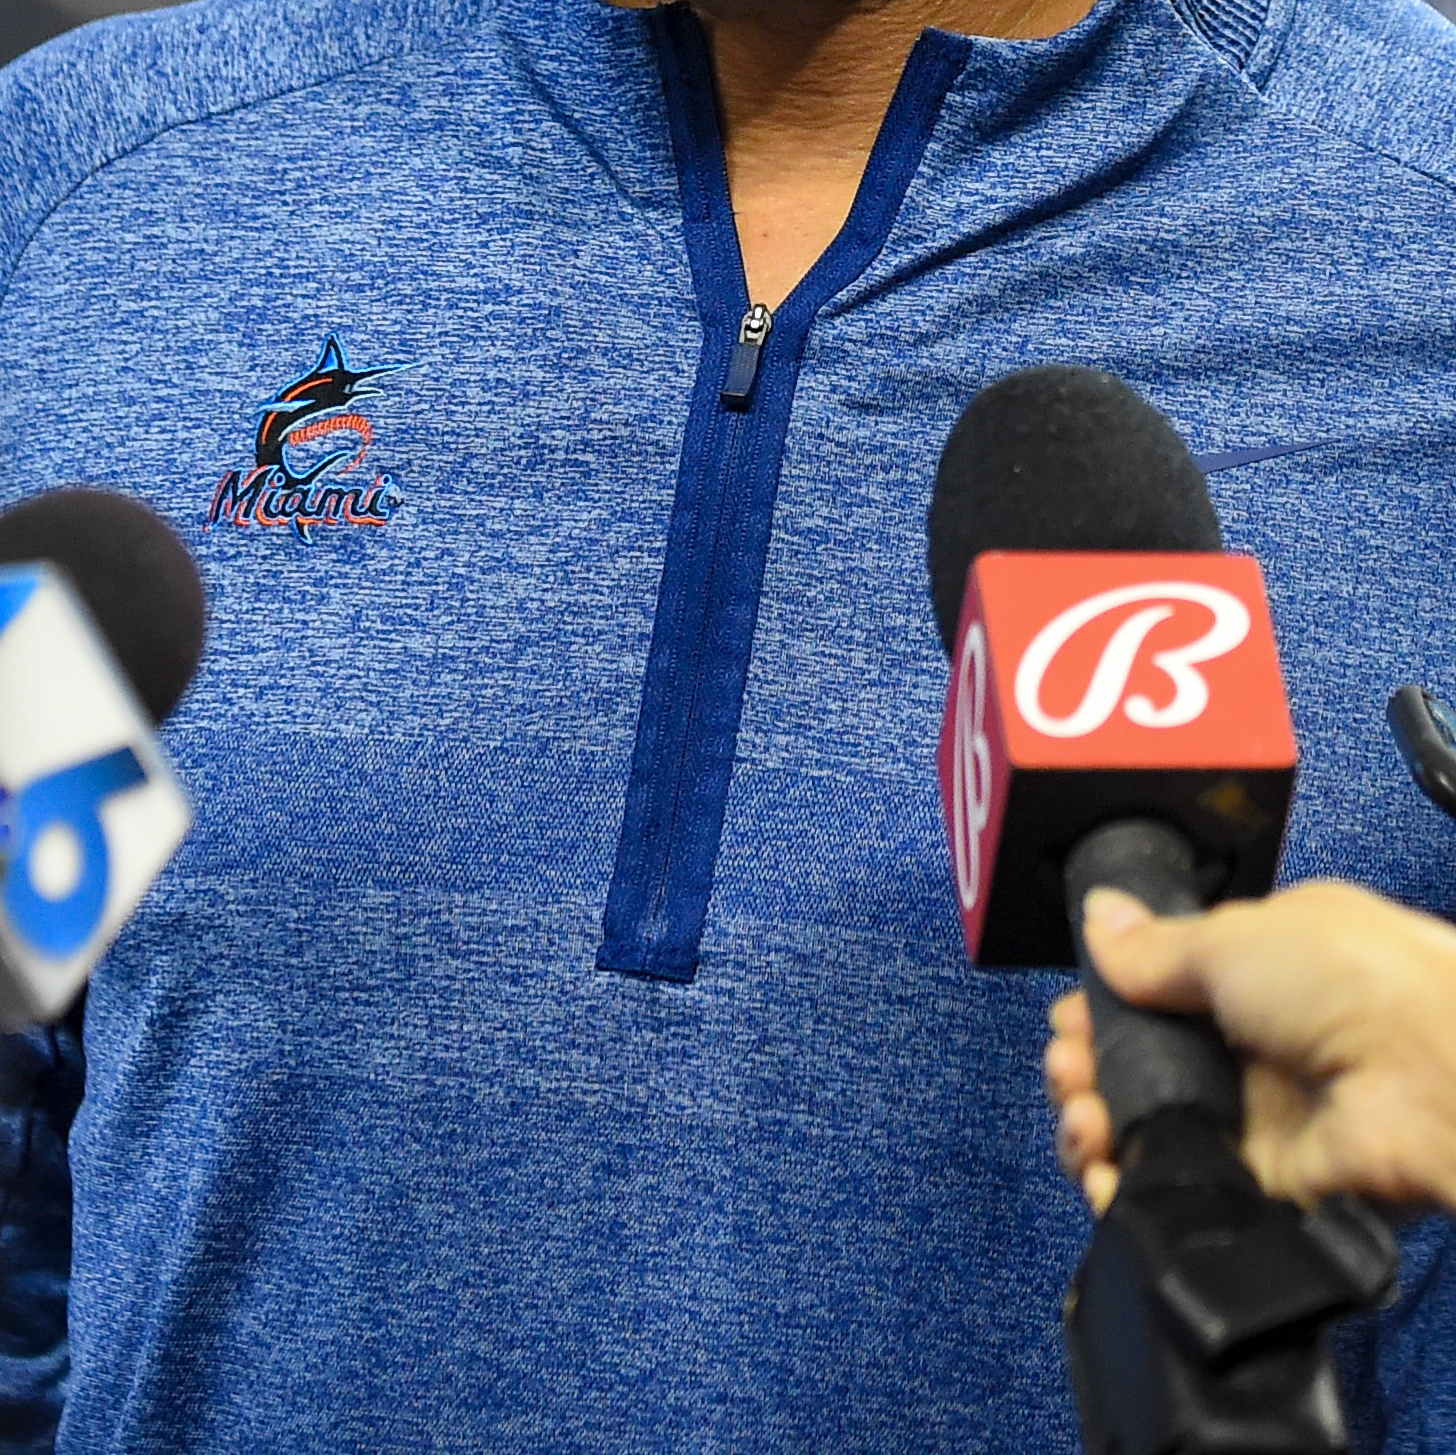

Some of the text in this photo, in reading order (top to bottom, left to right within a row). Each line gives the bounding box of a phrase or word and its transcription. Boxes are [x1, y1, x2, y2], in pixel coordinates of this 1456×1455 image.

[203, 464, 394, 533] Miami
[1014, 580, 1251, 738] B
[2, 745, 148, 960] 6
